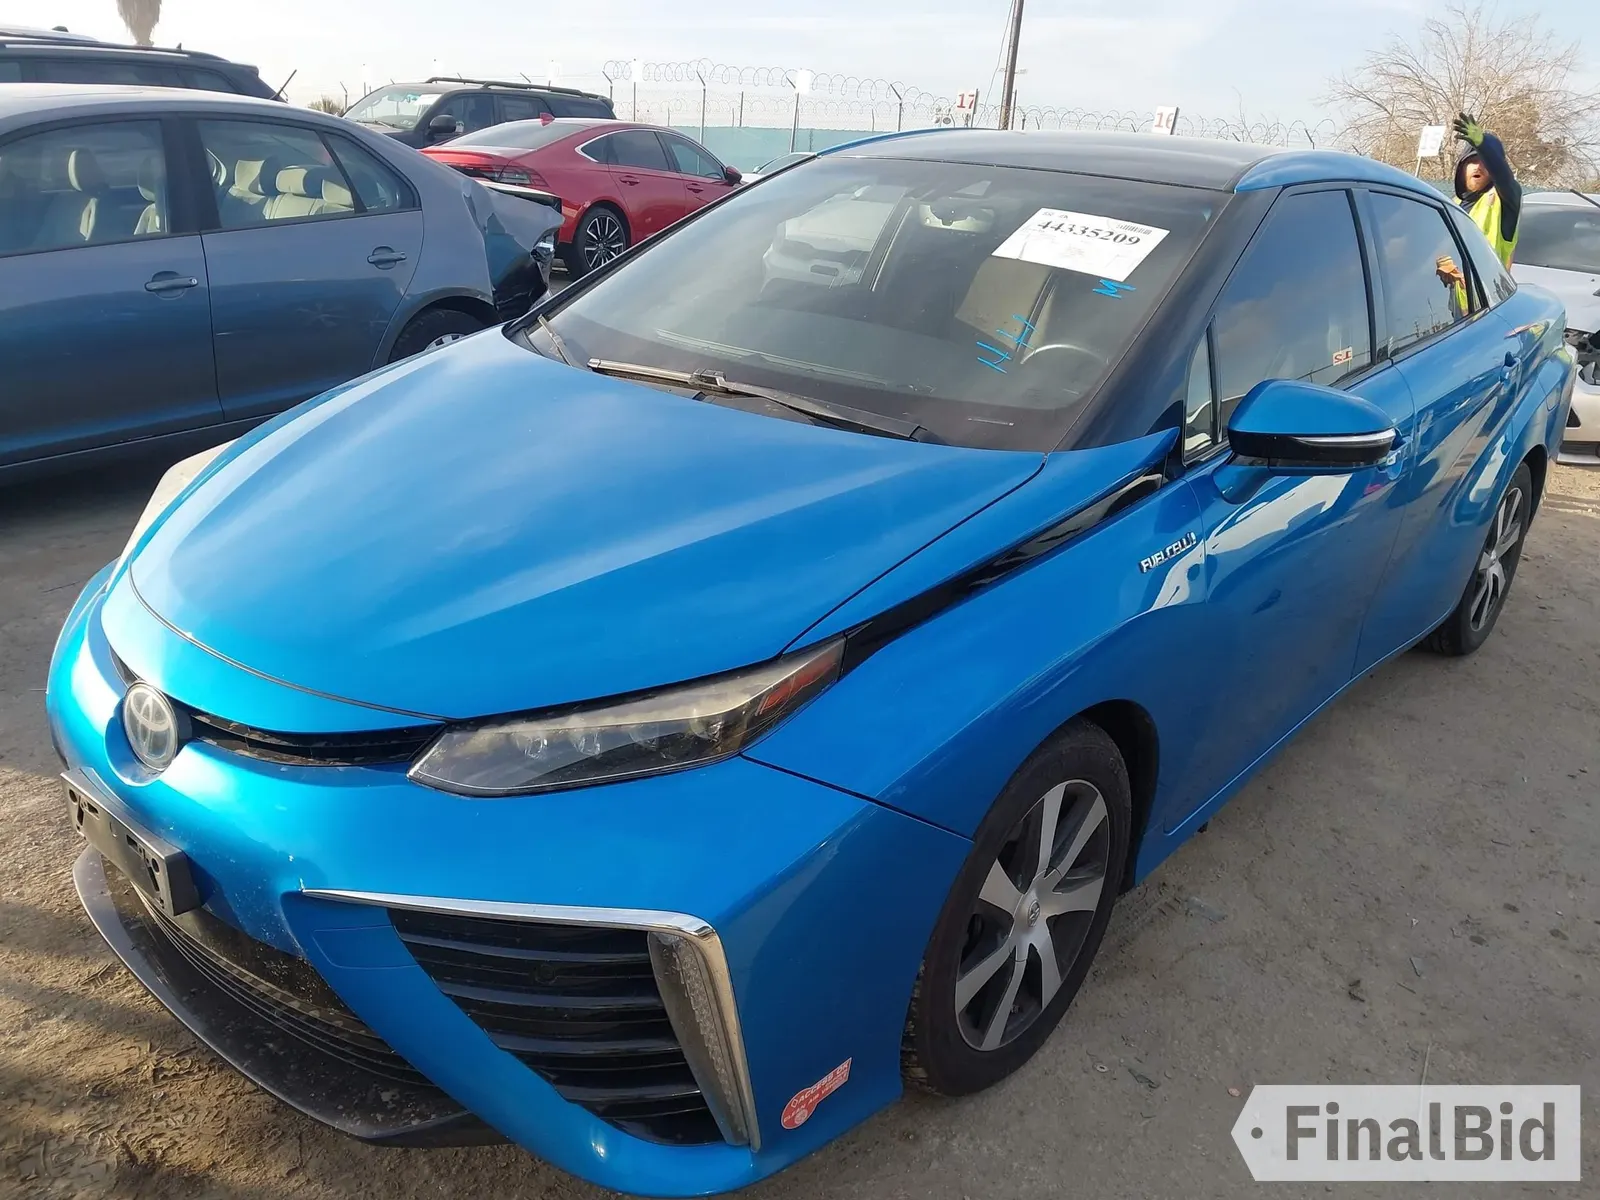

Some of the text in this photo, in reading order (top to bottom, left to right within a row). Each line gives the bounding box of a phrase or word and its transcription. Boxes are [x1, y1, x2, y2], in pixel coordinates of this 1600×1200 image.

[957, 93, 975, 110] 17
[1037, 220, 1141, 246] 44335209
[1140, 550, 1169, 574] FUEL
